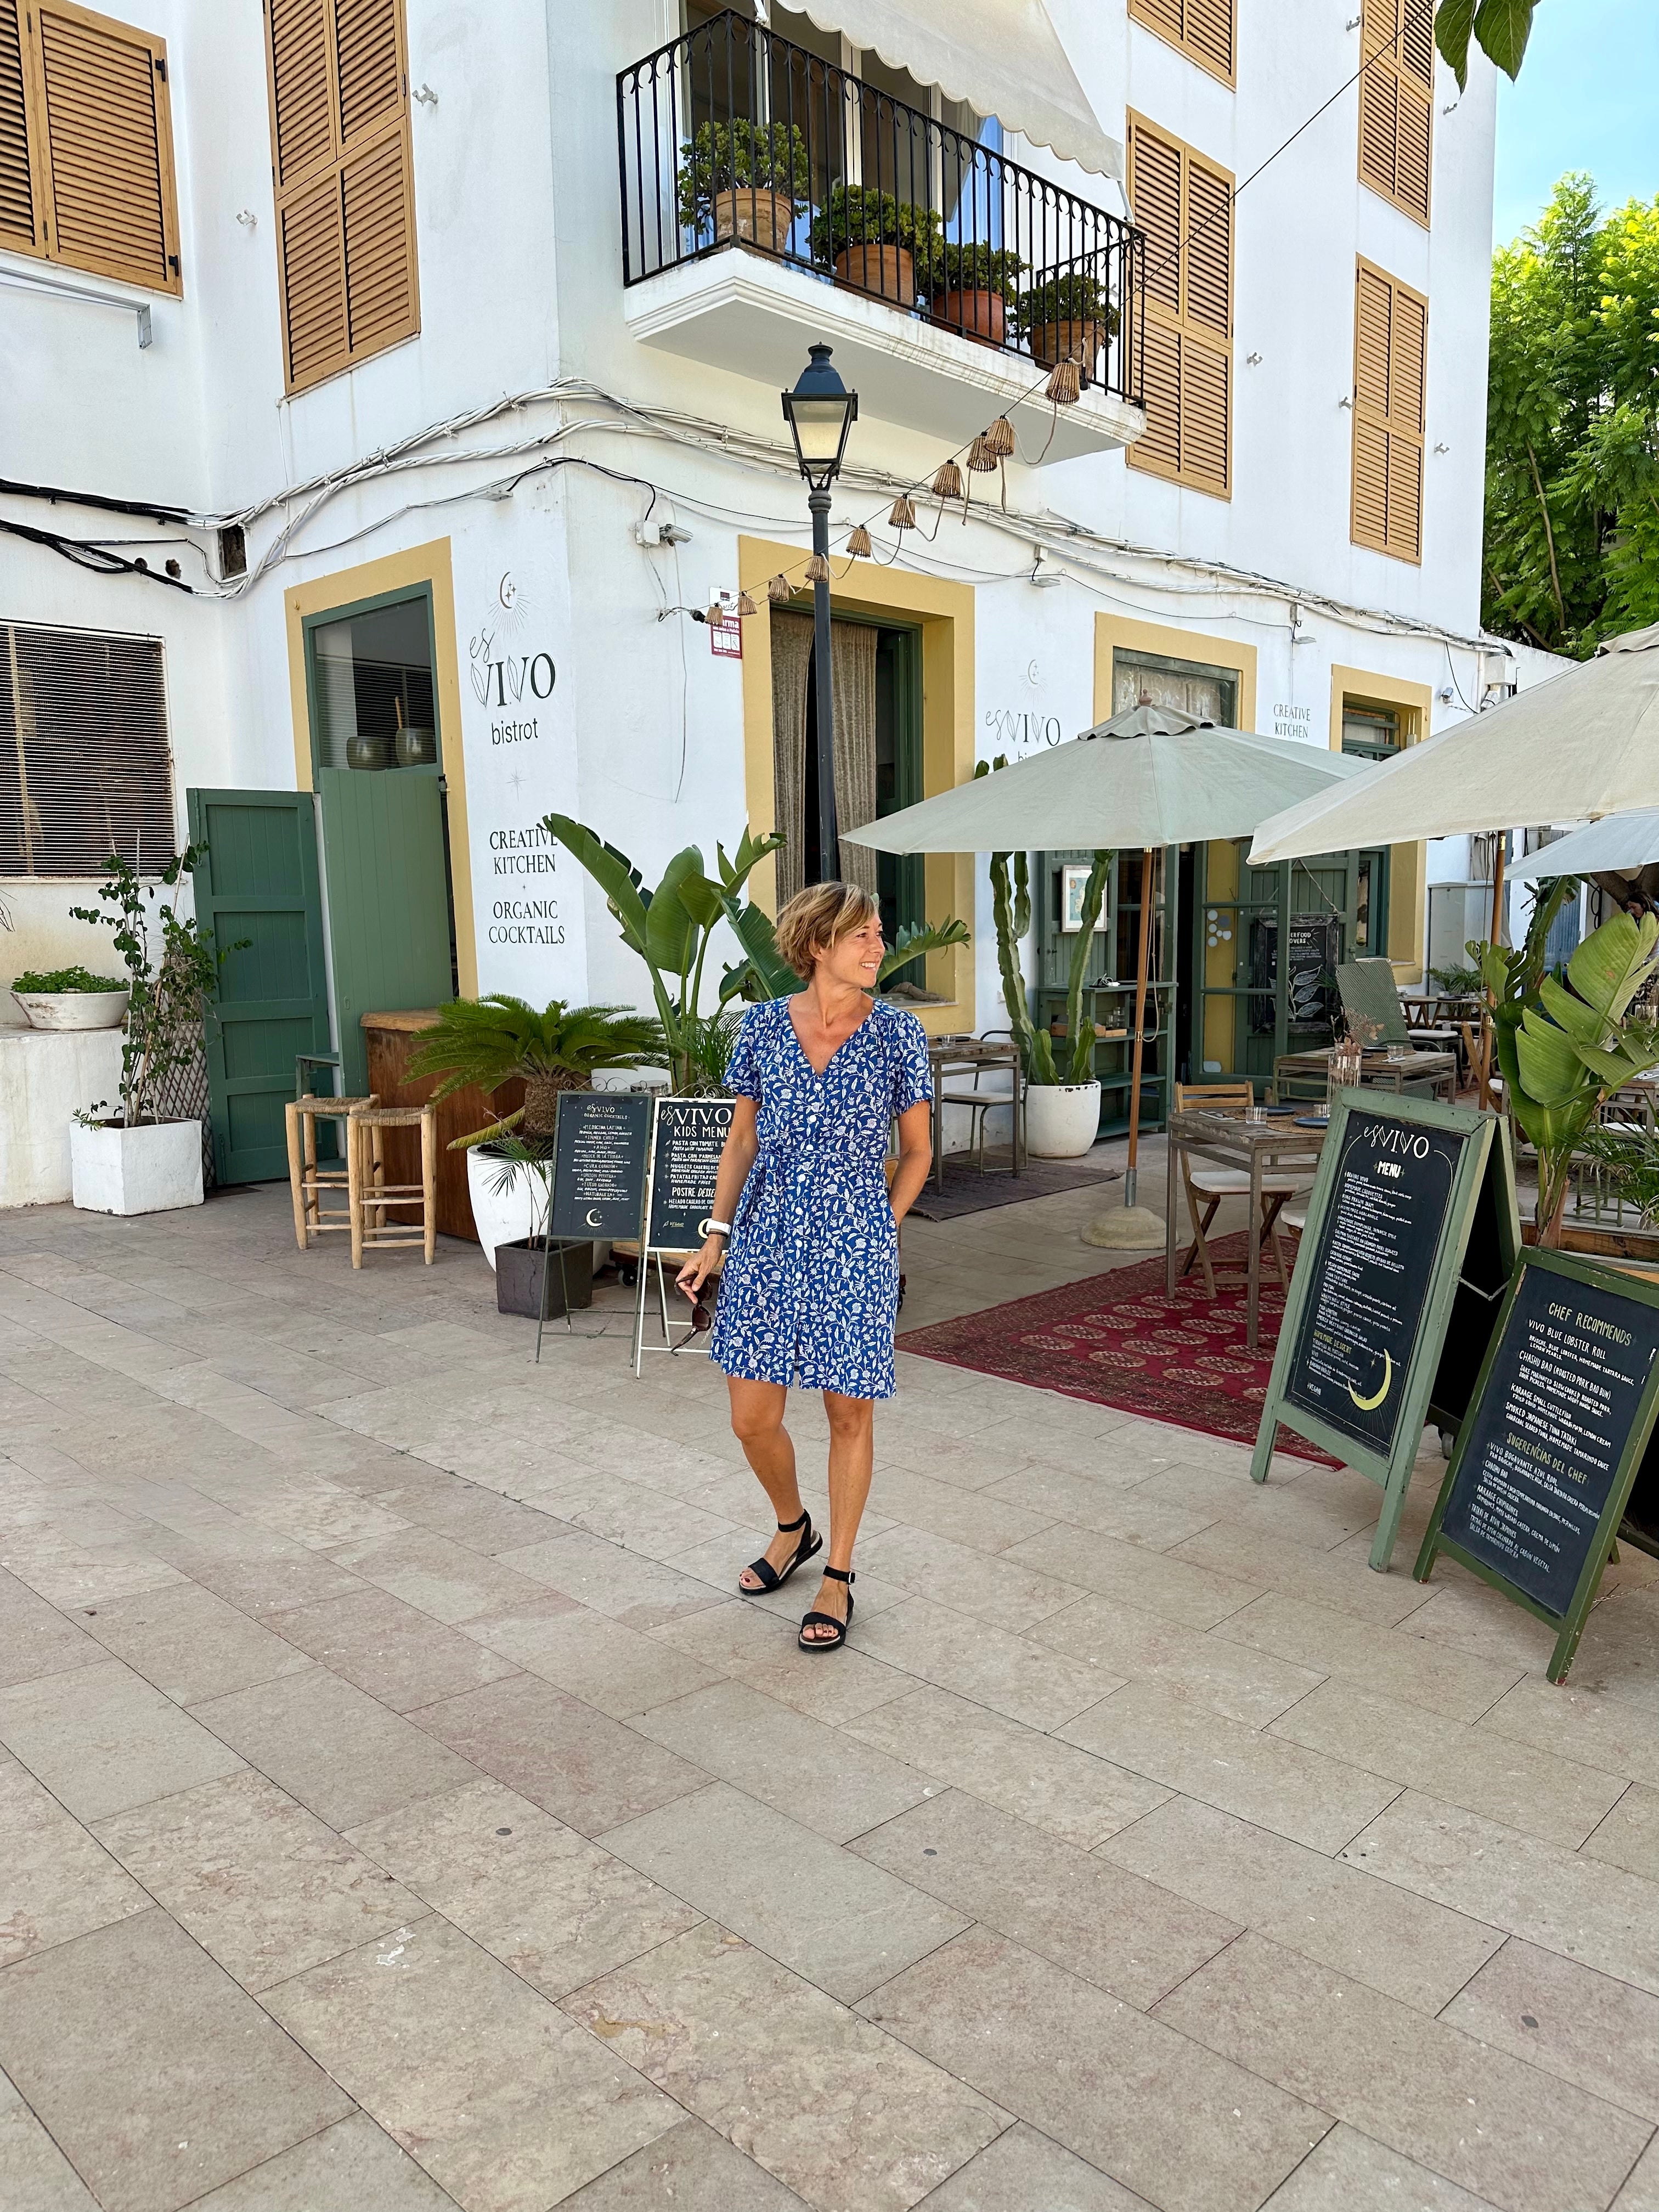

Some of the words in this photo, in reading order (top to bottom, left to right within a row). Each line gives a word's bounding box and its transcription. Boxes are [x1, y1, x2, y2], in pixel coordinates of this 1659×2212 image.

[470, 628, 495, 663] es
[471, 652, 556, 708] VIVO
[1273, 704, 1311, 721] CREATIVE
[492, 718, 538, 745] bistrot
[1275, 722, 1308, 738] KITCHEN
[489, 828, 557, 850] CREATIVE
[494, 854, 556, 874] KITCHEN
[493, 900, 558, 919] ORGANIC
[489, 926, 565, 944] COCKTAILS
[674, 1108, 731, 1125] VIVO
[674, 1126, 697, 1137] KIDS
[703, 1126, 731, 1138] MENU
[1377, 1160, 1401, 1178] MENU
[672, 1187, 696, 1197] POSTRE
[1549, 1302, 1572, 1321] CHEF
[1575, 1312, 1632, 1346] RECOMMENDS
[1333, 1339, 1352, 1354] DESSERT
[1528, 1319, 1544, 1333] VIVO
[1547, 1327, 1562, 1340] BLUE
[1564, 1334, 1589, 1353] LOBSTER
[1592, 1346, 1605, 1359] ROLL
[1530, 1342, 1545, 1352] LEMON
[1545, 1348, 1562, 1360] PEARLS.
[1548, 1343, 1559, 1352] BLUE
[1560, 1348, 1578, 1362] LOBSTER,
[1578, 1356, 1601, 1370] HOMEMADE
[1602, 1367, 1620, 1379] TARTARA
[1519, 1350, 1541, 1367] CHASHU
[1541, 1360, 1553, 1372] BAO
[1553, 1365, 1576, 1382] (ROASTED
[1576, 1375, 1589, 1389] PORK
[1589, 1382, 1599, 1393] BAO
[1599, 1387, 1611, 1400] BUN)
[1520, 1364, 1531, 1374] SAKE
[1530, 1370, 1552, 1384] MARINATED
[1581, 1394, 1599, 1407] ROASTED
[1309, 1383, 1321, 1395] VEGAN
[1510, 1383, 1533, 1400] KARAAGE
[1533, 1394, 1546, 1407] SMALL
[1529, 1376, 1545, 1389] PICKLES,
[1546, 1384, 1566, 1398] HOMEMADE
[1505, 1401, 1525, 1417] SMOKED
[1525, 1412, 1548, 1430] JAPANESE
[1549, 1424, 1560, 1436] TUNA
[1560, 1430, 1577, 1446] TATAKI
[1513, 1393, 1525, 1402] FRIED
[1537, 1406, 1558, 1419] HOMEMADE
[1583, 1429, 1596, 1440] LEMON
[1596, 1436, 1611, 1448] CREAM
[1490, 1442, 1503, 1455] VIVO
[1504, 1450, 1533, 1471] BOGAVANTE
[1533, 1467, 1545, 1479] AZUL
[1548, 1435, 1572, 1452] HOMEMADE
[1573, 1448, 1597, 1464] TAMARINDO
[1485, 1460, 1500, 1474] CHASHU
[1551, 1458, 1565, 1474] DEL
[1567, 1466, 1587, 1484] CHEF
[1476, 1484, 1497, 1502] KARAAGE
[1496, 1497, 1518, 1516] CHIPIRONES
[1531, 1529, 1543, 1542] CREMA
